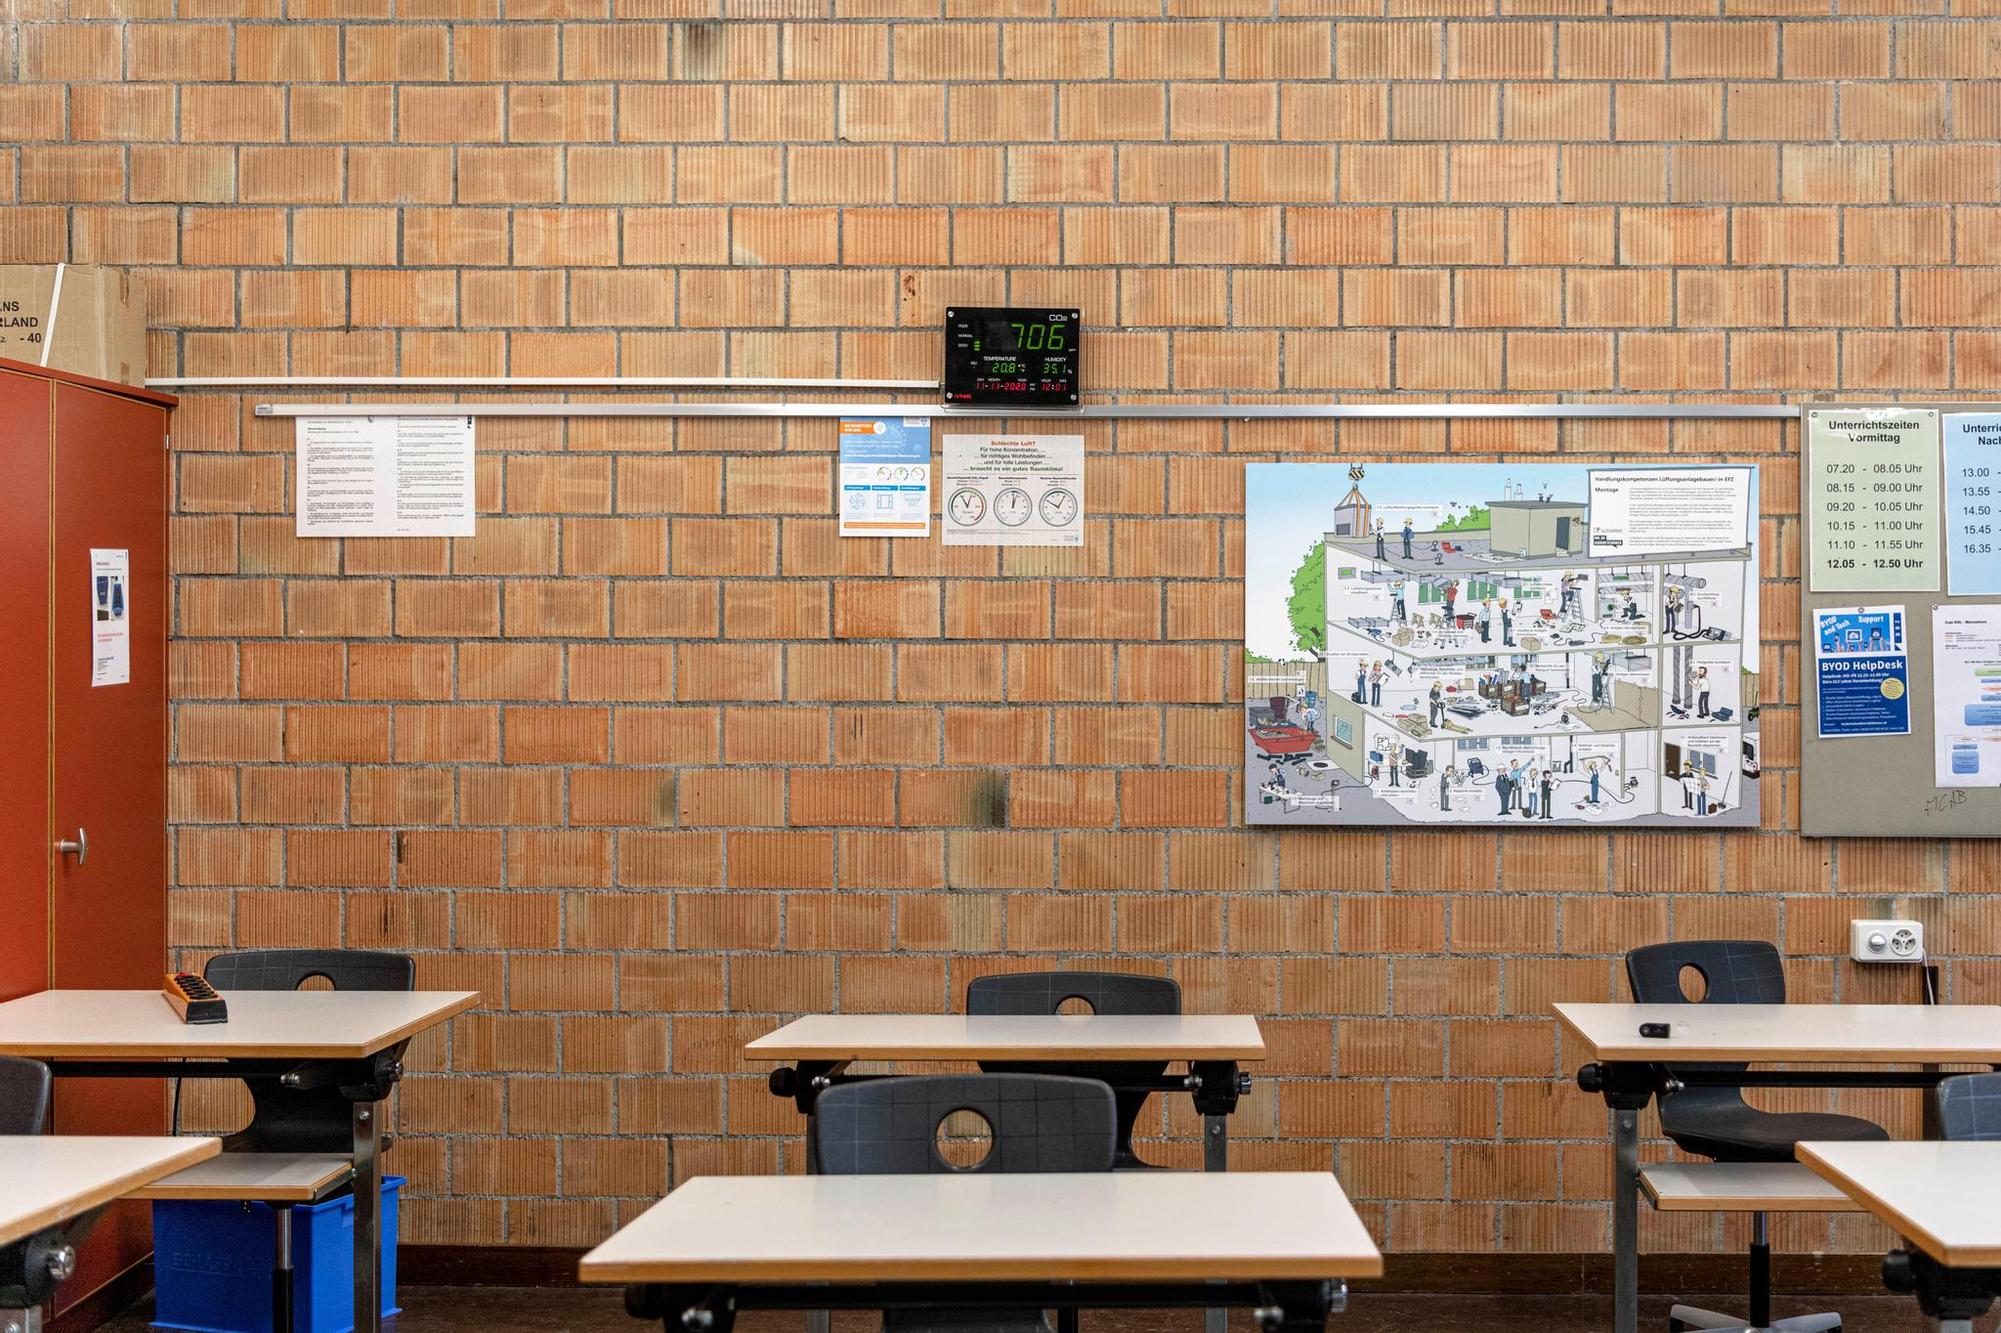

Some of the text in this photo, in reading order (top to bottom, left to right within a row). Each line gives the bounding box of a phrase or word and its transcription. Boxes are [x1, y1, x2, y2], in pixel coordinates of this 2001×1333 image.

[0, 301, 20, 312] NS
[27, 333, 41, 343] 40
[1010, 324, 1065, 350] 706
[992, 363, 1016, 373] 20.8
[1044, 364, 1066, 374] 35.1
[1829, 420, 1919, 430] Unterrichtszeiten
[1848, 433, 1900, 444] Vormittag
[1827, 464, 1855, 473] 07.20
[1873, 464, 1902, 473] 08.05
[1905, 464, 1922, 473] Uhr
[1963, 468, 1989, 477] 13.00
[1827, 483, 1855, 492] 08.15
[1873, 483, 1901, 492] 09.00
[1905, 483, 1923, 492] Uhr
[1963, 487, 1990, 496] 13.55
[1827, 502, 1855, 512] 09.20
[1875, 502, 1902, 512] 10.05
[1905, 502, 1923, 512] Uhr
[1963, 506, 1990, 515] 14.50
[1828, 522, 1855, 530] 10.15
[1875, 522, 1902, 530] 11.00
[1905, 522, 1923, 530] Uhr
[1964, 526, 1991, 534] 15.45
[1827, 541, 1855, 549] 11.10
[1875, 541, 1902, 549] 11.55
[1905, 541, 1923, 549] Uhr
[1964, 544, 1991, 553] 16.35
[1827, 559, 1854, 568] 12.05
[1873, 559, 1900, 568] 12.50
[1904, 559, 1923, 568] Uhr
[1820, 616, 1837, 628] BYOD
[1824, 620, 1850, 635] and Tech
[1822, 660, 1903, 671] BYOD HelpDesk
